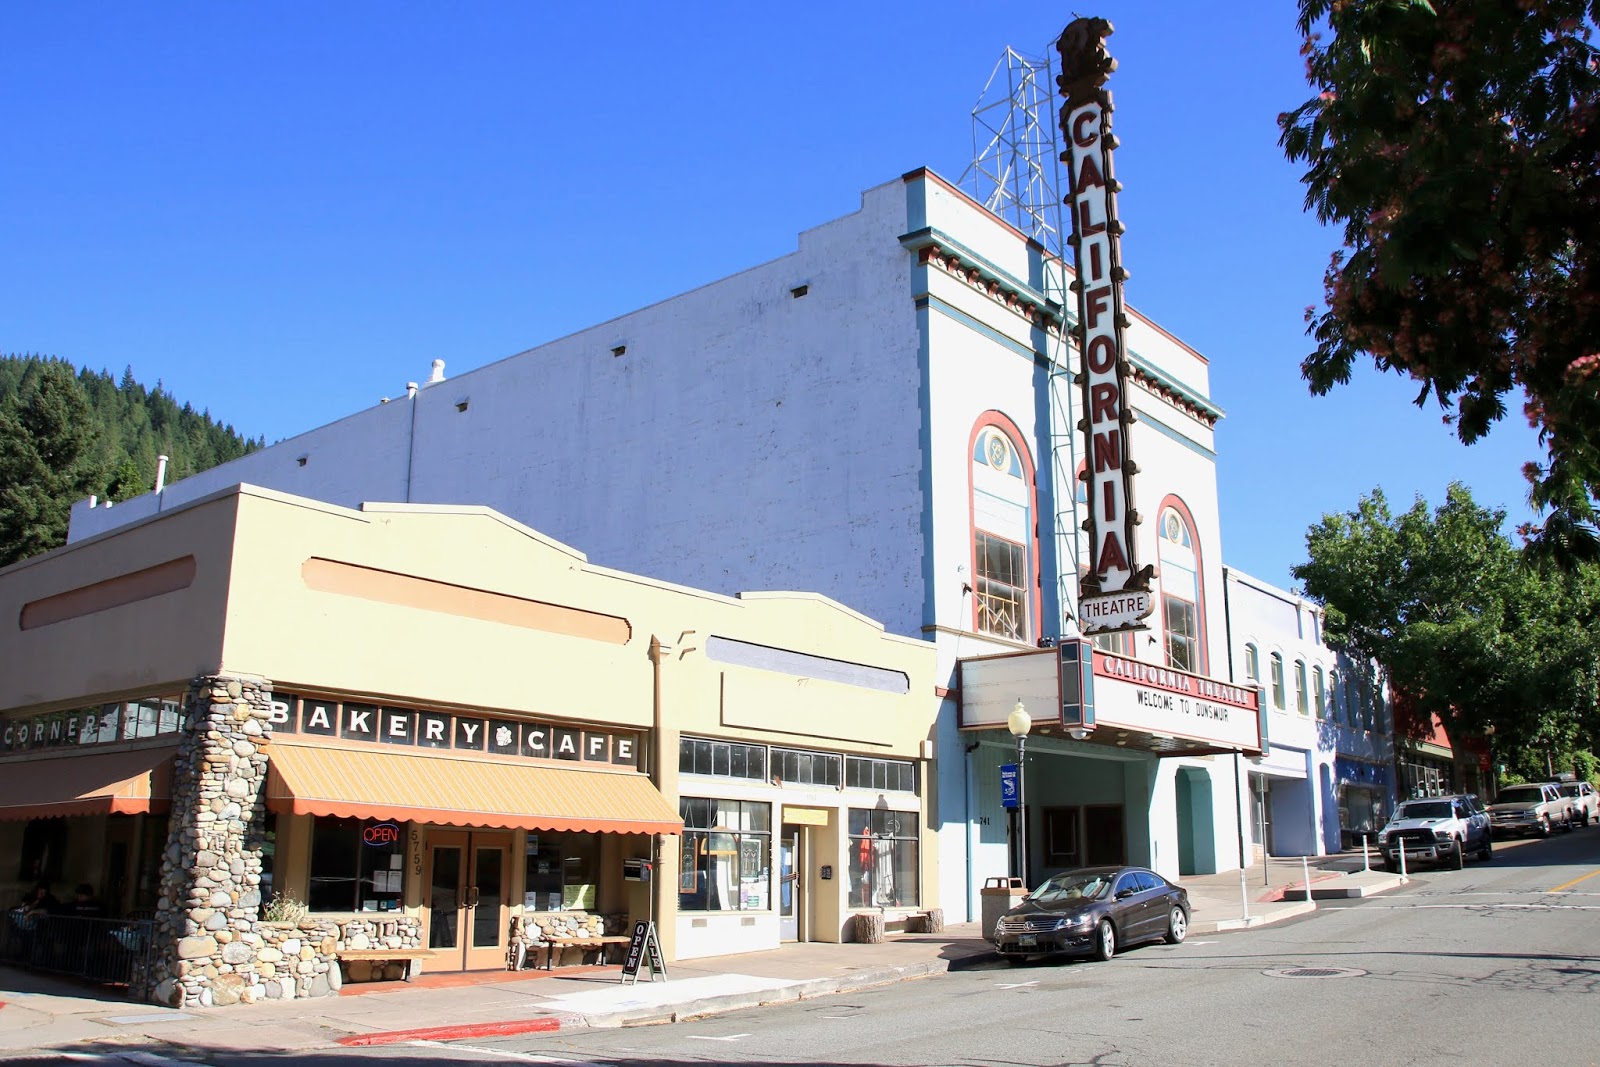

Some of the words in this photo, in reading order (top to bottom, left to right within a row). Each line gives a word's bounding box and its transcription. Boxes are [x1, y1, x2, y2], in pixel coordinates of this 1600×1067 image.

[1072, 110, 1128, 574] CALIFORNIA
[1085, 597, 1144, 618] THEATRE
[1103, 656, 1190, 692] CALIFORNIA
[1196, 679, 1248, 704] THEATRE
[1136, 689, 1174, 711] WELCOME
[1180, 698, 1189, 714] TO
[1196, 702, 1229, 722] DUNSMUIR
[268, 701, 480, 743] BAKERY
[528, 731, 632, 759] CAFE
[363, 828, 398, 841] OPEN
[411, 830, 422, 875] 5759
[627, 925, 644, 968] OPEN
